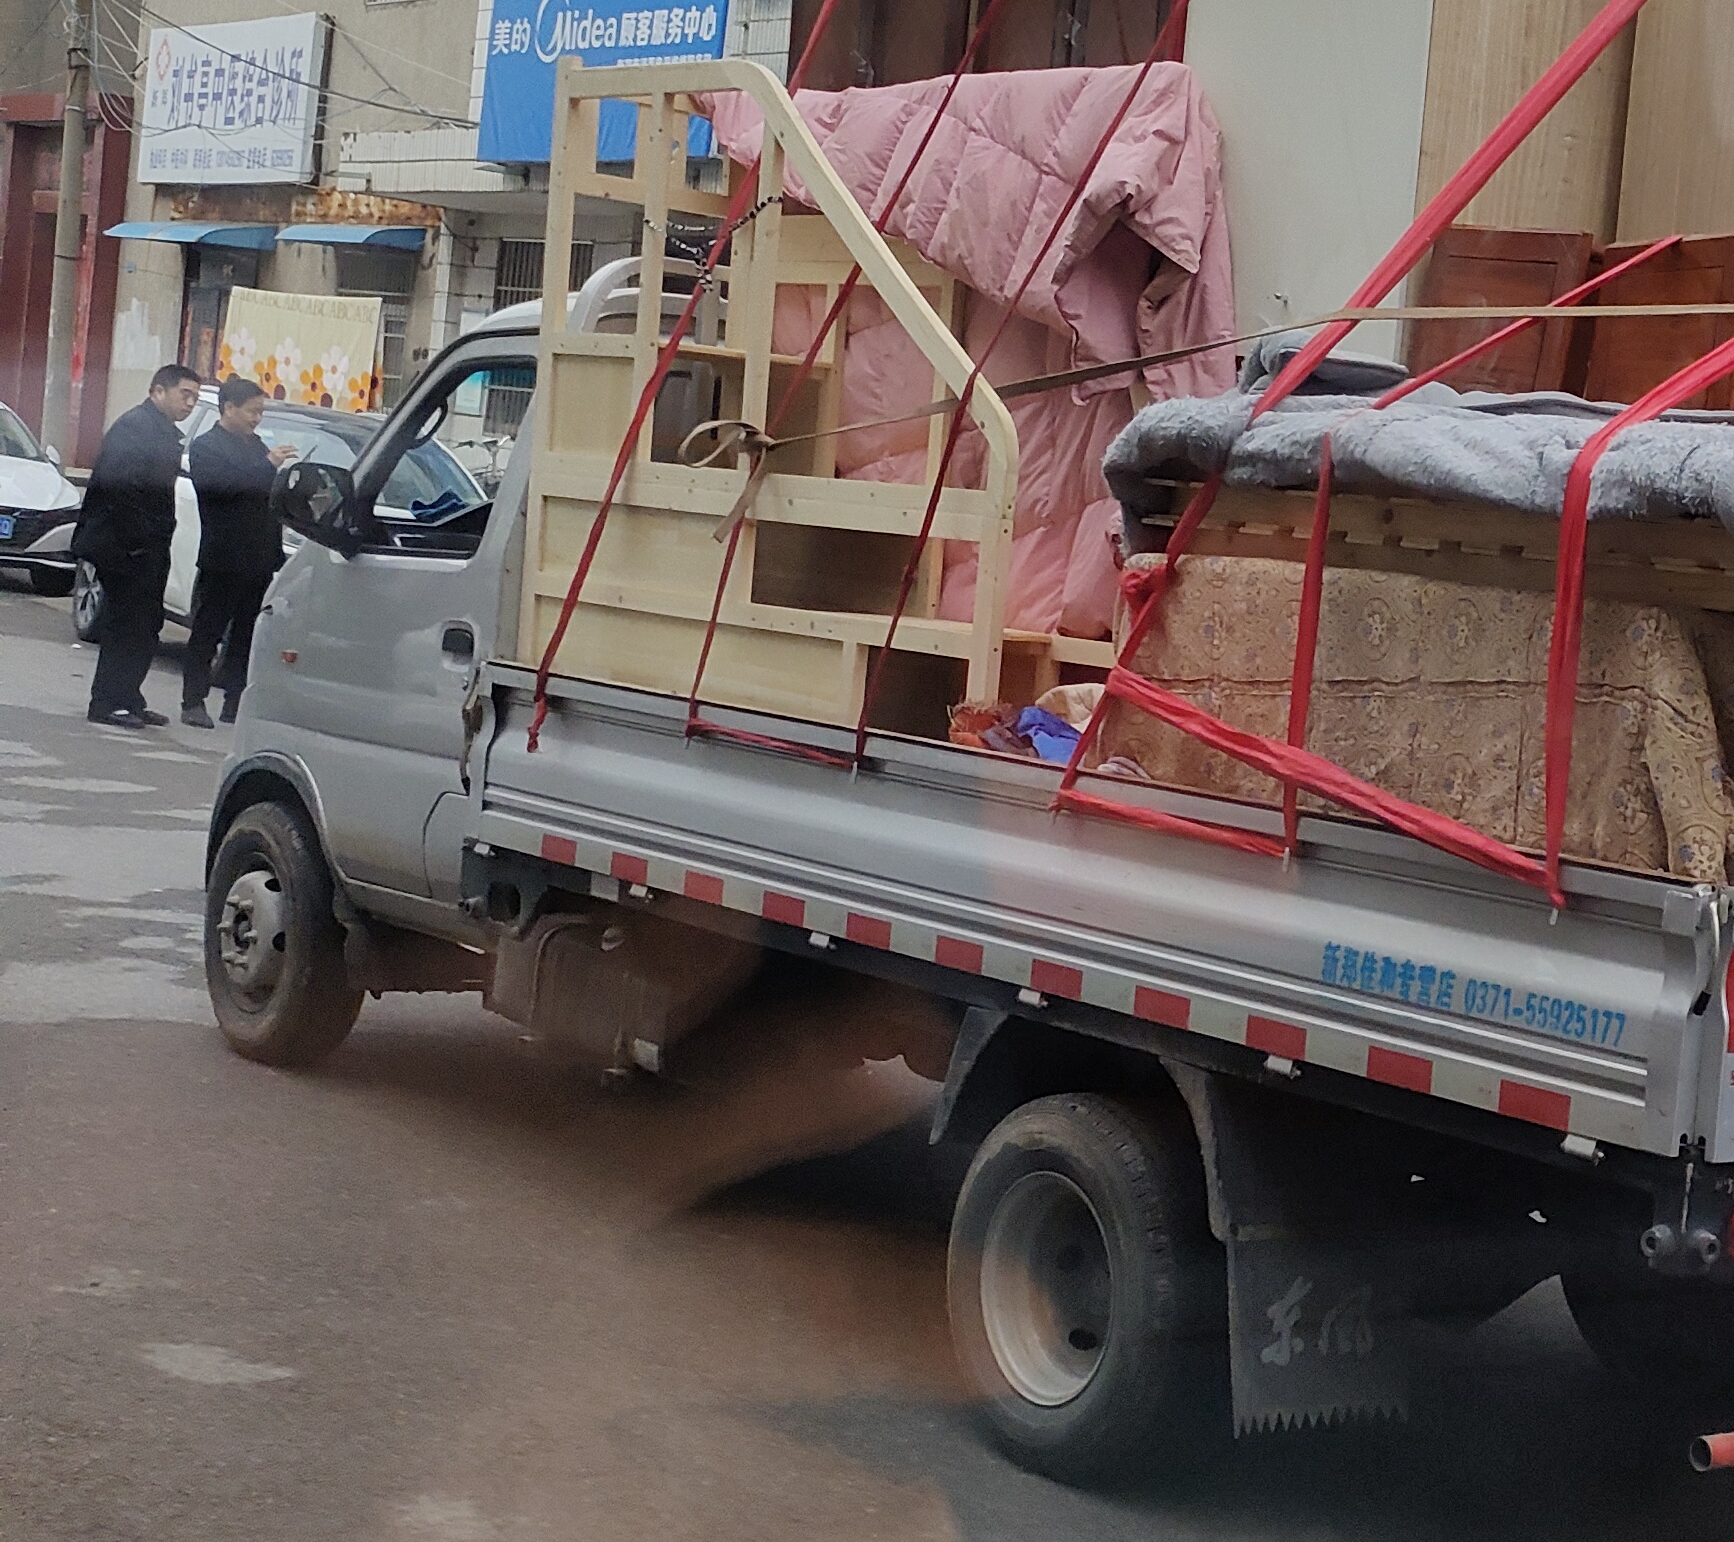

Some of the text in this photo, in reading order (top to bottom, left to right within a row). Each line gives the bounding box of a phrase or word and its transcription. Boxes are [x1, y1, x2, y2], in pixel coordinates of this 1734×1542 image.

[492, 17, 531, 55] 美的
[618, 4, 717, 47] 顾客服务中心
[1463, 977, 1627, 1047] 0371-55925177
